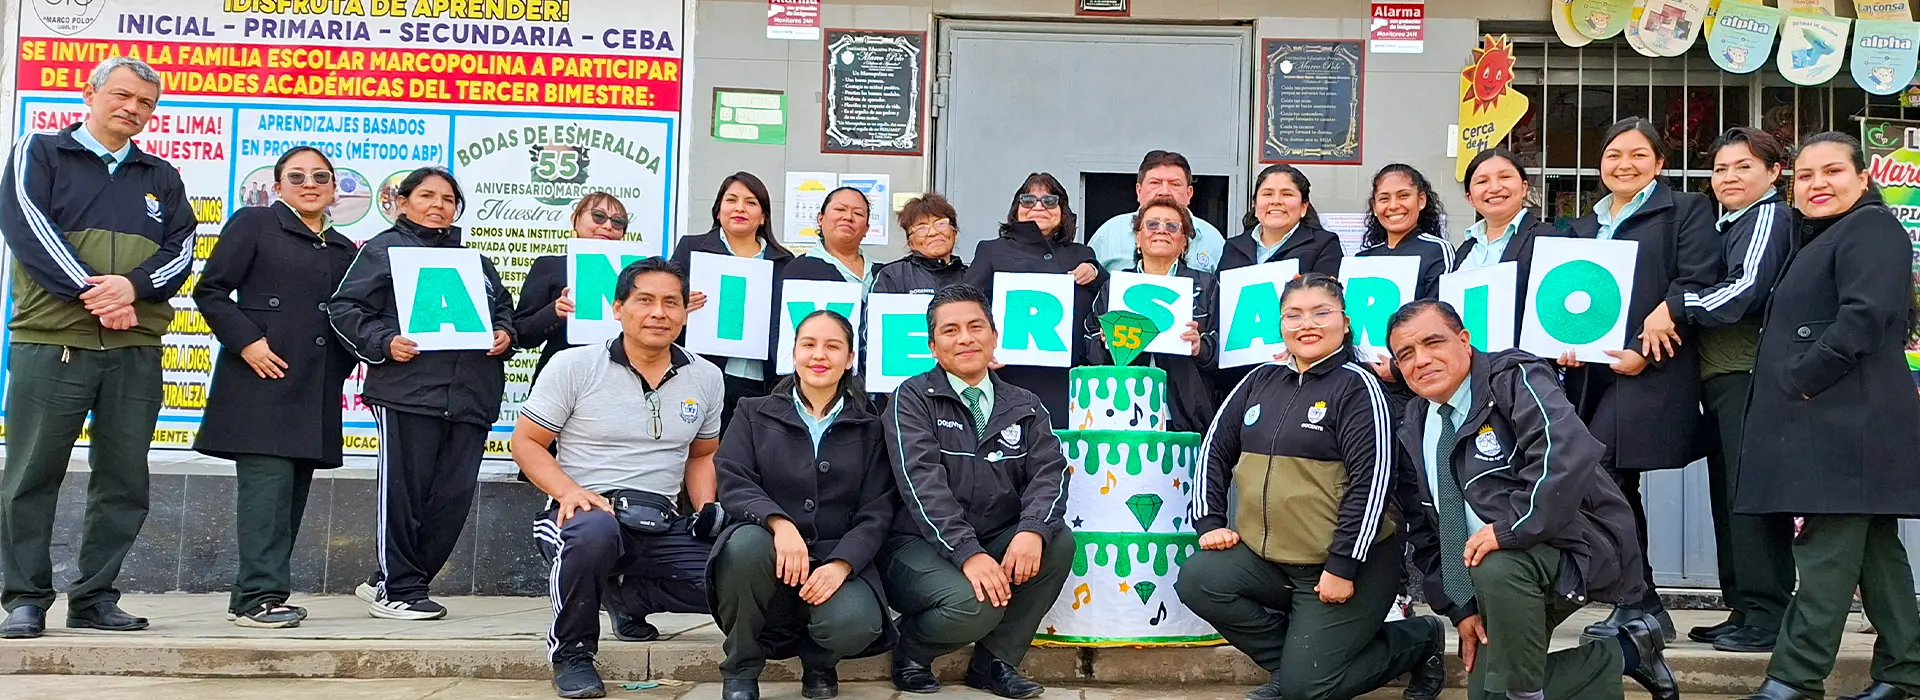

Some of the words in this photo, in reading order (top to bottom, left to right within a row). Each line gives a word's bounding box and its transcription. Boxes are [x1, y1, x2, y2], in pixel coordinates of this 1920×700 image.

[371, 0, 407, 17] DE
[412, 0, 569, 22] APRENDER!
[1373, 5, 1421, 18] Alarma
[117, 14, 215, 36] INICIAL
[244, 18, 371, 41] PRIMARIA
[399, 22, 573, 47] SECUNDARIA
[602, 29, 675, 51] CEBA
[1720, 15, 1770, 35] alpha
[1860, 35, 1912, 50] alpha
[21, 41, 46, 61] SE
[52, 42, 119, 62] INVITA
[124, 44, 141, 60] A
[146, 45, 174, 65] LA
[178, 45, 261, 68] FAMILIA
[267, 49, 365, 70] ESCOLAR
[370, 51, 526, 76] MARCOPOLINA
[531, 57, 546, 77] A
[551, 57, 678, 82] PARTICIPAR
[40, 67, 68, 88] DE
[158, 71, 258, 94] IVIDADES
[262, 70, 404, 98] ACADÉMICAS
[409, 78, 451, 100] DEL
[456, 80, 539, 102] TERCER
[544, 83, 655, 107] BIMESTRE:
[148, 115, 171, 133] DE
[176, 115, 222, 135] LIMA!
[258, 114, 359, 133] APRENDIZAJES
[363, 118, 426, 136] BASADOS
[1462, 121, 1495, 141] Cerca
[145, 139, 224, 160] NUESTRA
[241, 139, 260, 156] EN
[346, 138, 410, 162] (MÉTODO
[412, 143, 443, 164] ABP)
[456, 129, 518, 168] BODAS
[523, 125, 548, 145] DE
[554, 124, 661, 175] ESMERALDA
[1466, 139, 1477, 149] de
[1476, 136, 1488, 152] ti
[538, 151, 580, 178] 55
[474, 182, 552, 197] ANIVERSARIO
[477, 199, 563, 222] Nuestra
[470, 227, 503, 237] SOMOS
[505, 228, 525, 238] UNA
[527, 229, 573, 239] INSTITUCI
[465, 241, 505, 252] PRIVADA
[508, 243, 527, 253] QUE
[503, 257, 509, 266] Y
[408, 267, 487, 334] A
[575, 253, 648, 321] N
[716, 274, 747, 341] I
[881, 313, 938, 377] E
[1002, 289, 1068, 352] R
[1123, 283, 1180, 333] S
[1224, 281, 1282, 352] A
[1343, 276, 1401, 347] R
[1462, 284, 1489, 352] I
[1535, 259, 1622, 345] O
[1112, 325, 1142, 349] 55
[513, 393, 528, 403] LA
[937, 419, 964, 431] DOCENTE
